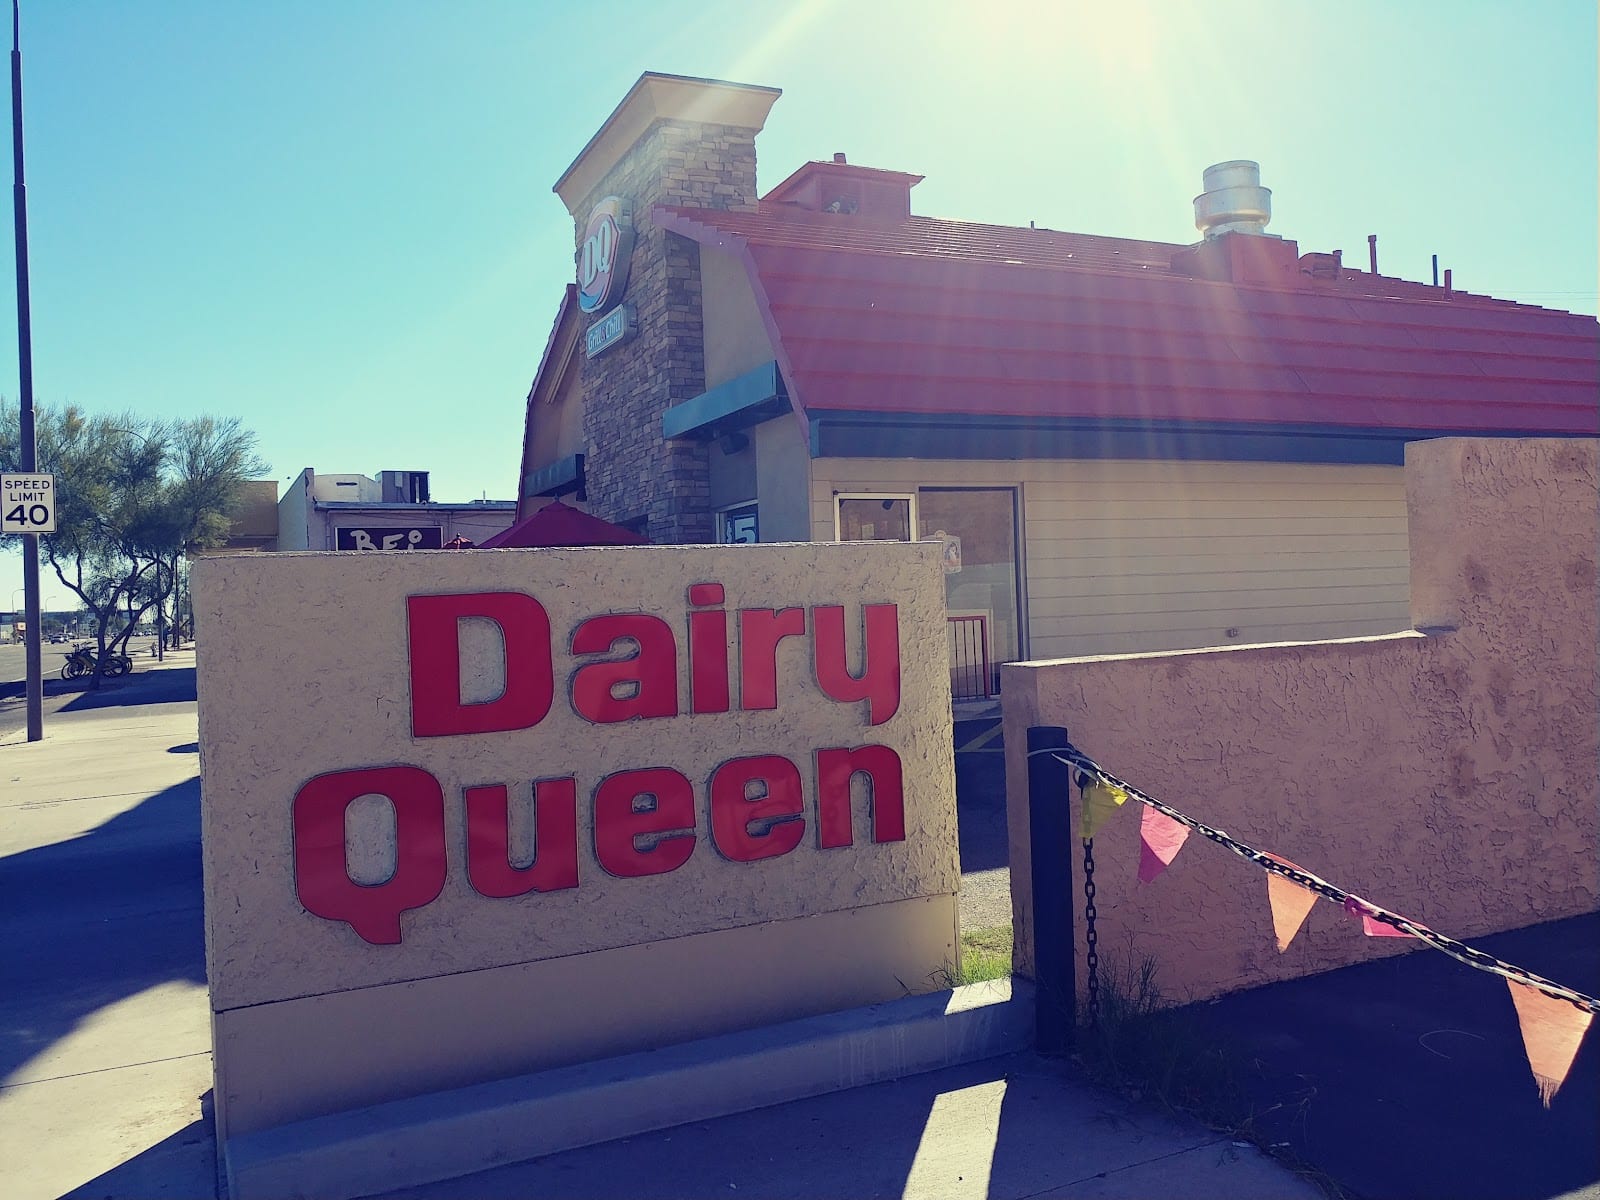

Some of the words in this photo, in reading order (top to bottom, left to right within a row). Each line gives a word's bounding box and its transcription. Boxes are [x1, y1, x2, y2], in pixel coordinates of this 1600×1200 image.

[583, 220, 612, 289] DQ
[4, 480, 50, 490] SPEED
[9, 492, 46, 502] LIMIT
[5, 504, 49, 526] 40
[407, 582, 901, 738] Dairy
[292, 744, 906, 945] Queen
